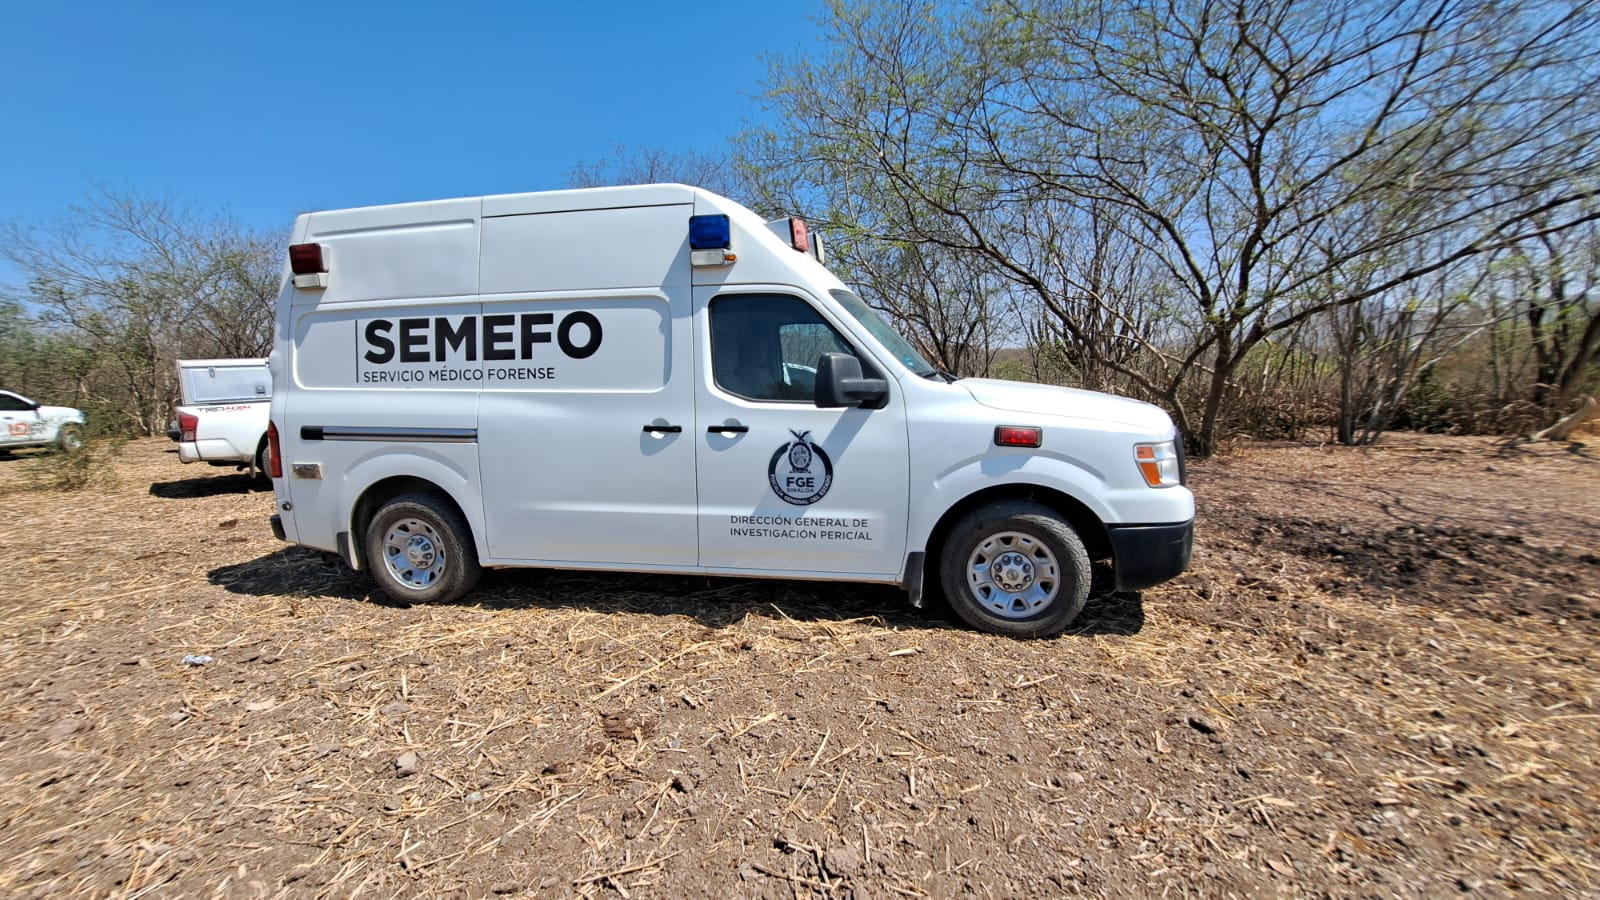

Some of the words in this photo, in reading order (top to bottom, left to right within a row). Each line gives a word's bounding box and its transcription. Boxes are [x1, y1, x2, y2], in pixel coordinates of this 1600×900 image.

[364, 310, 603, 364] SEMEFO
[363, 370, 425, 383] SERVICIO
[429, 365, 483, 382] MÉDICO
[488, 367, 556, 380] FORENSE
[786, 476, 815, 488] FGE
[730, 515, 791, 526] DIRECCIÓN
[795, 517, 849, 528] GENERAL
[853, 519, 869, 528] DE
[730, 528, 817, 539] INVESTIGACIÓN
